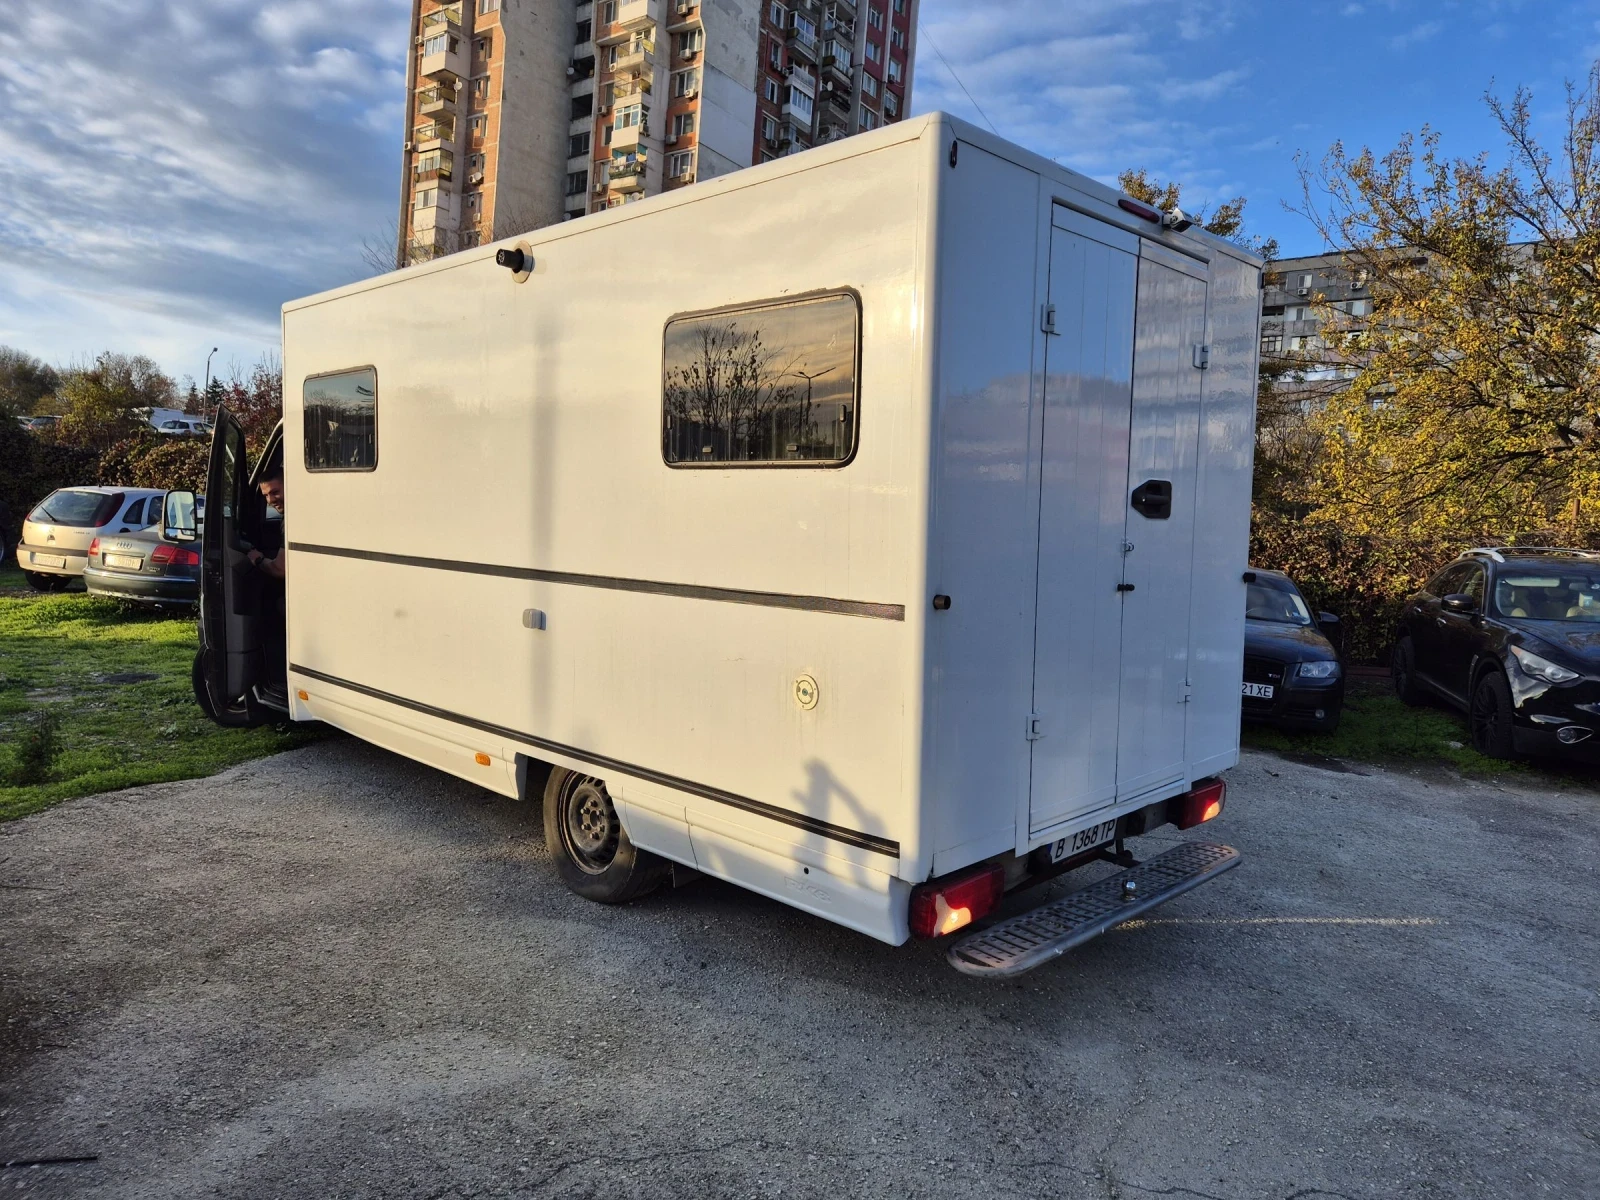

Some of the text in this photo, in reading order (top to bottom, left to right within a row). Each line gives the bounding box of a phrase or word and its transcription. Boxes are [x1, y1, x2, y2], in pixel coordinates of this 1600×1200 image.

[1256, 685, 1272, 698] XE
[1055, 818, 1116, 859] B 1368 TP
